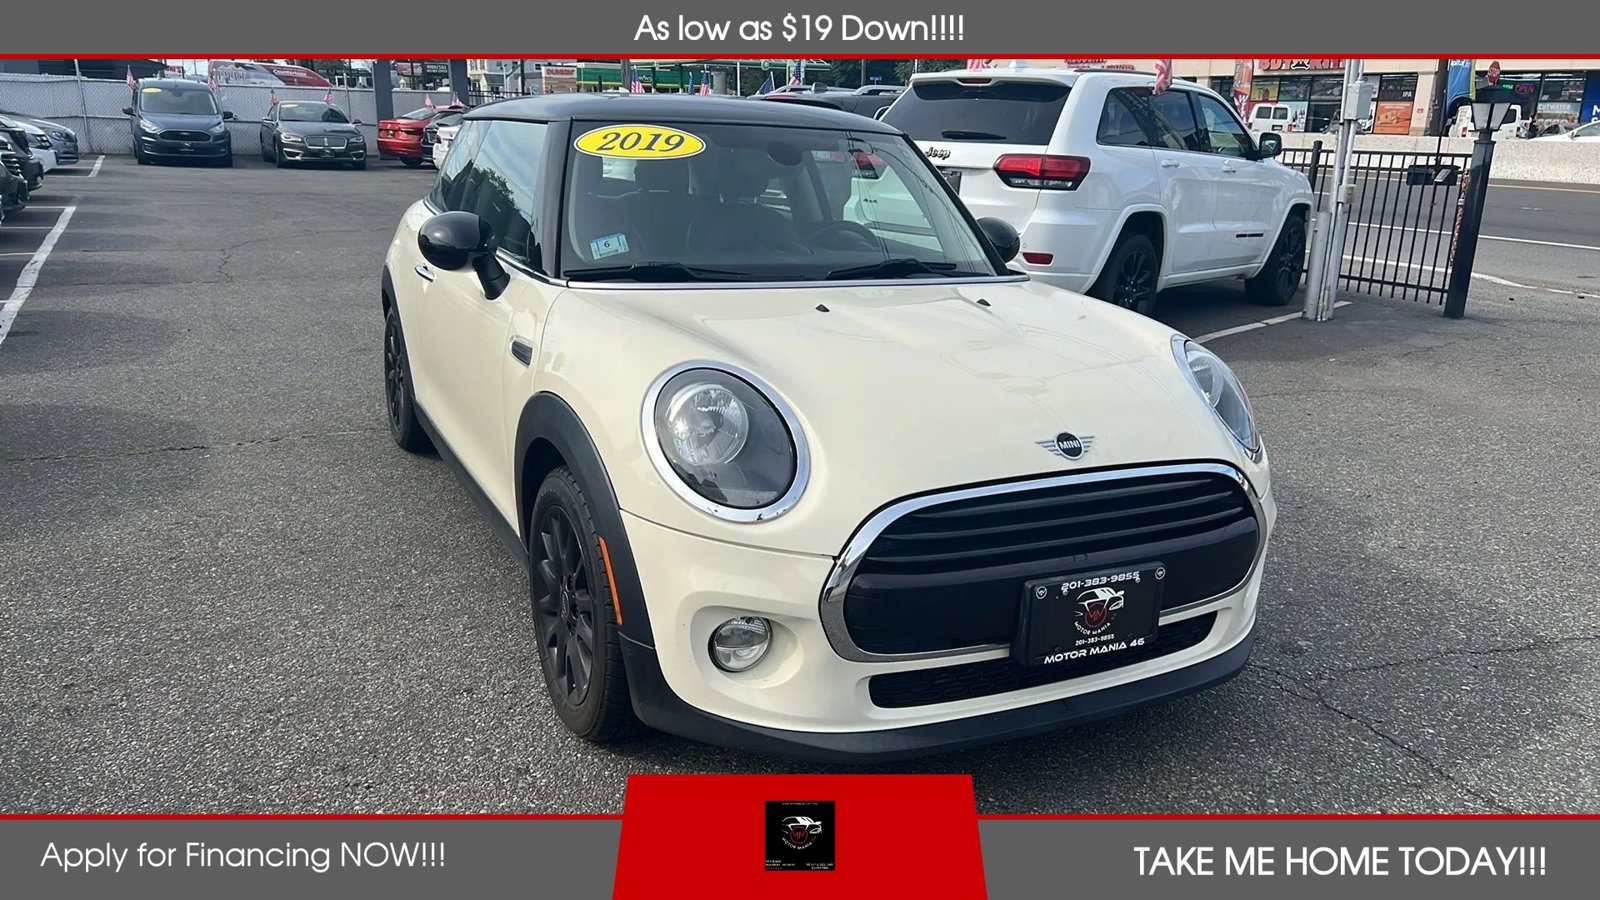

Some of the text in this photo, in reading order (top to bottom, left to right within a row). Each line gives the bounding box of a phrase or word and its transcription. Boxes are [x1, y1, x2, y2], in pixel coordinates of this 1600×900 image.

[596, 132, 687, 153] 2019
[925, 146, 951, 161] Jeep
[1059, 440, 1081, 450] MINI
[1061, 571, 1140, 590] 201-383-9855
[1074, 620, 1092, 635] MOTOR
[1043, 636, 1146, 665] MOTOR MANIA 46
